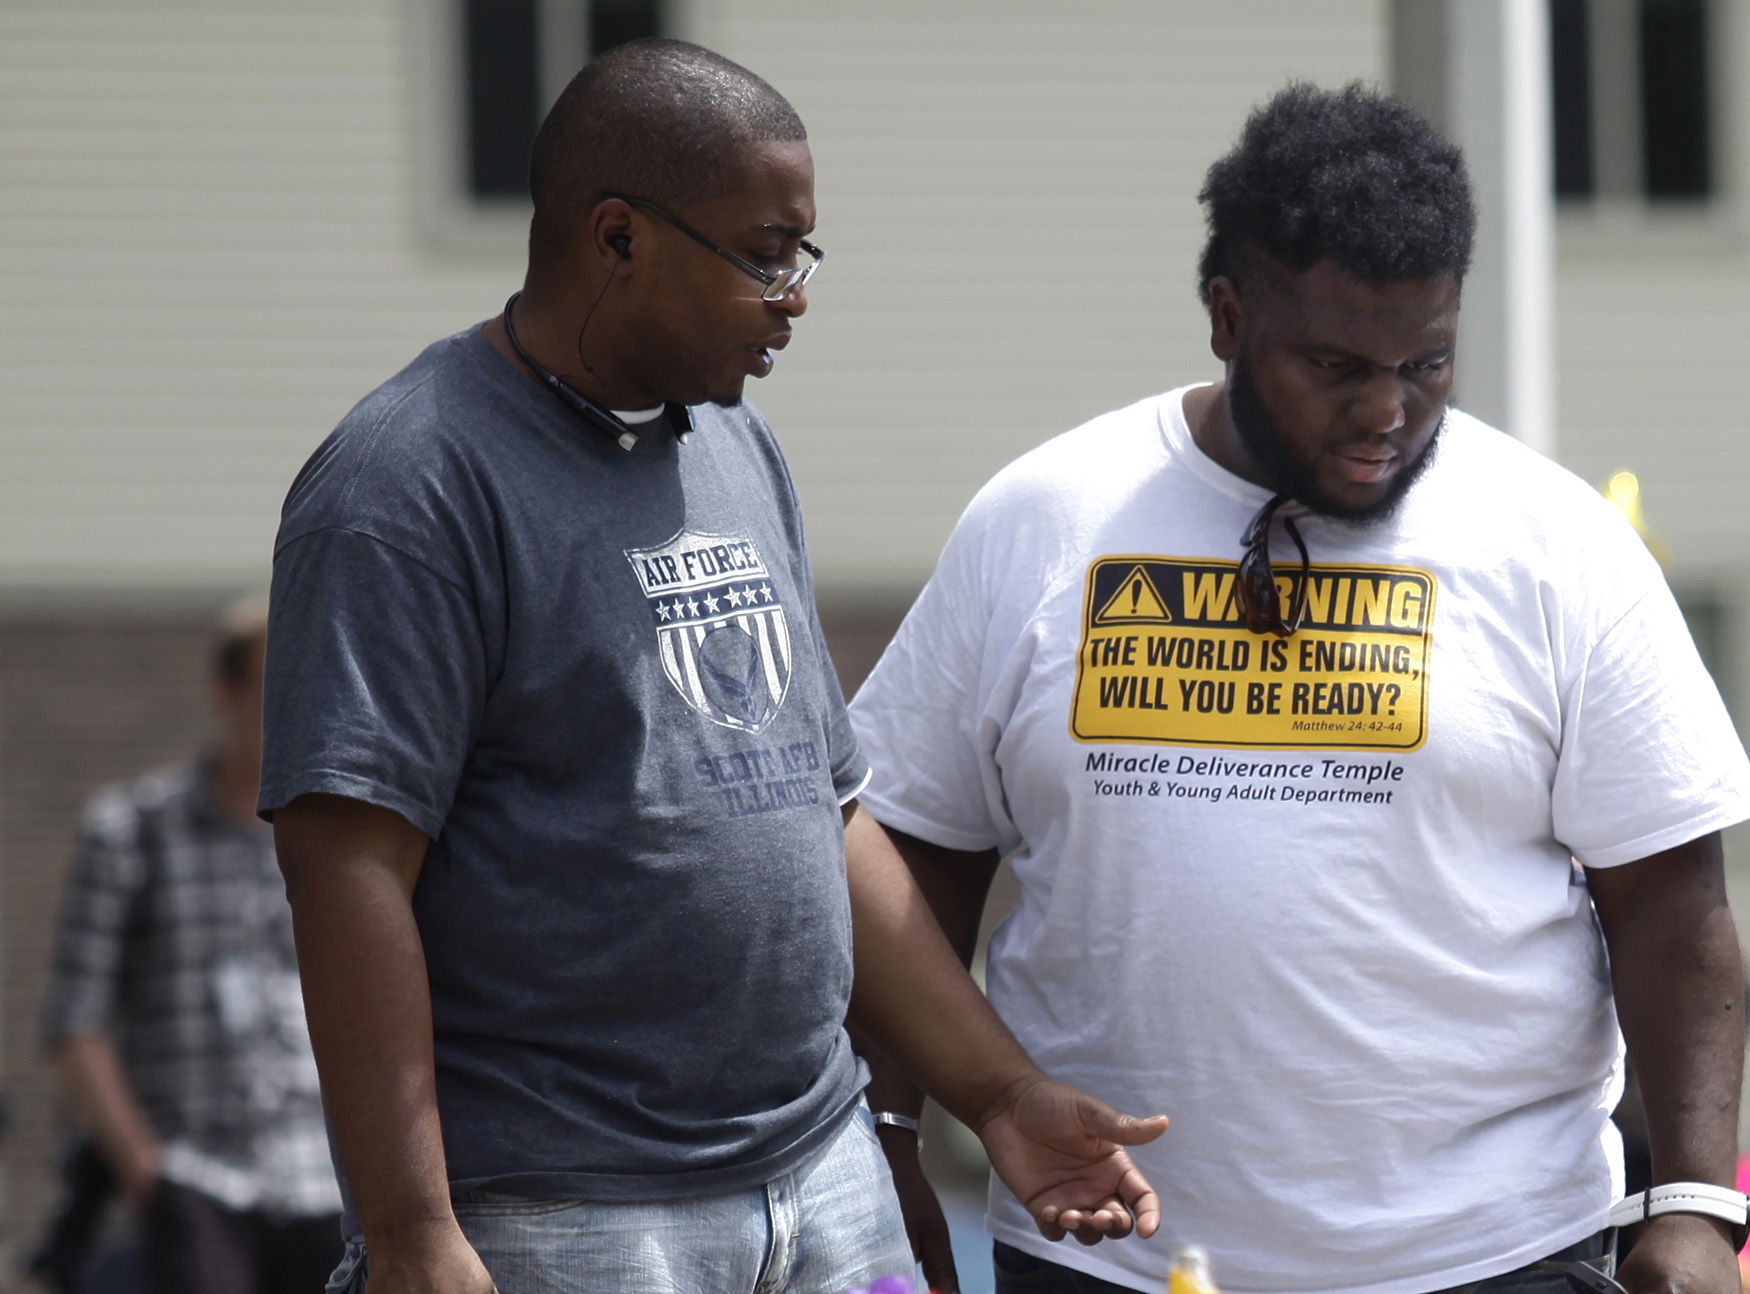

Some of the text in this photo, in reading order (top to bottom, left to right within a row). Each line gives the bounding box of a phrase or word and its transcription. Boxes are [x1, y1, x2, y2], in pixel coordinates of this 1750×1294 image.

[642, 541, 760, 588] AIR FORCE
[1090, 636, 1421, 681] THE WORLD IS ENDING,
[1100, 676, 1402, 716] WILL YOU BE READY?
[1291, 719, 1403, 733] Matthew 24: 42-44
[1085, 752, 1405, 787] Miracle Deliverance Temple
[1093, 779, 1394, 805] Youth & Young Adult Department
